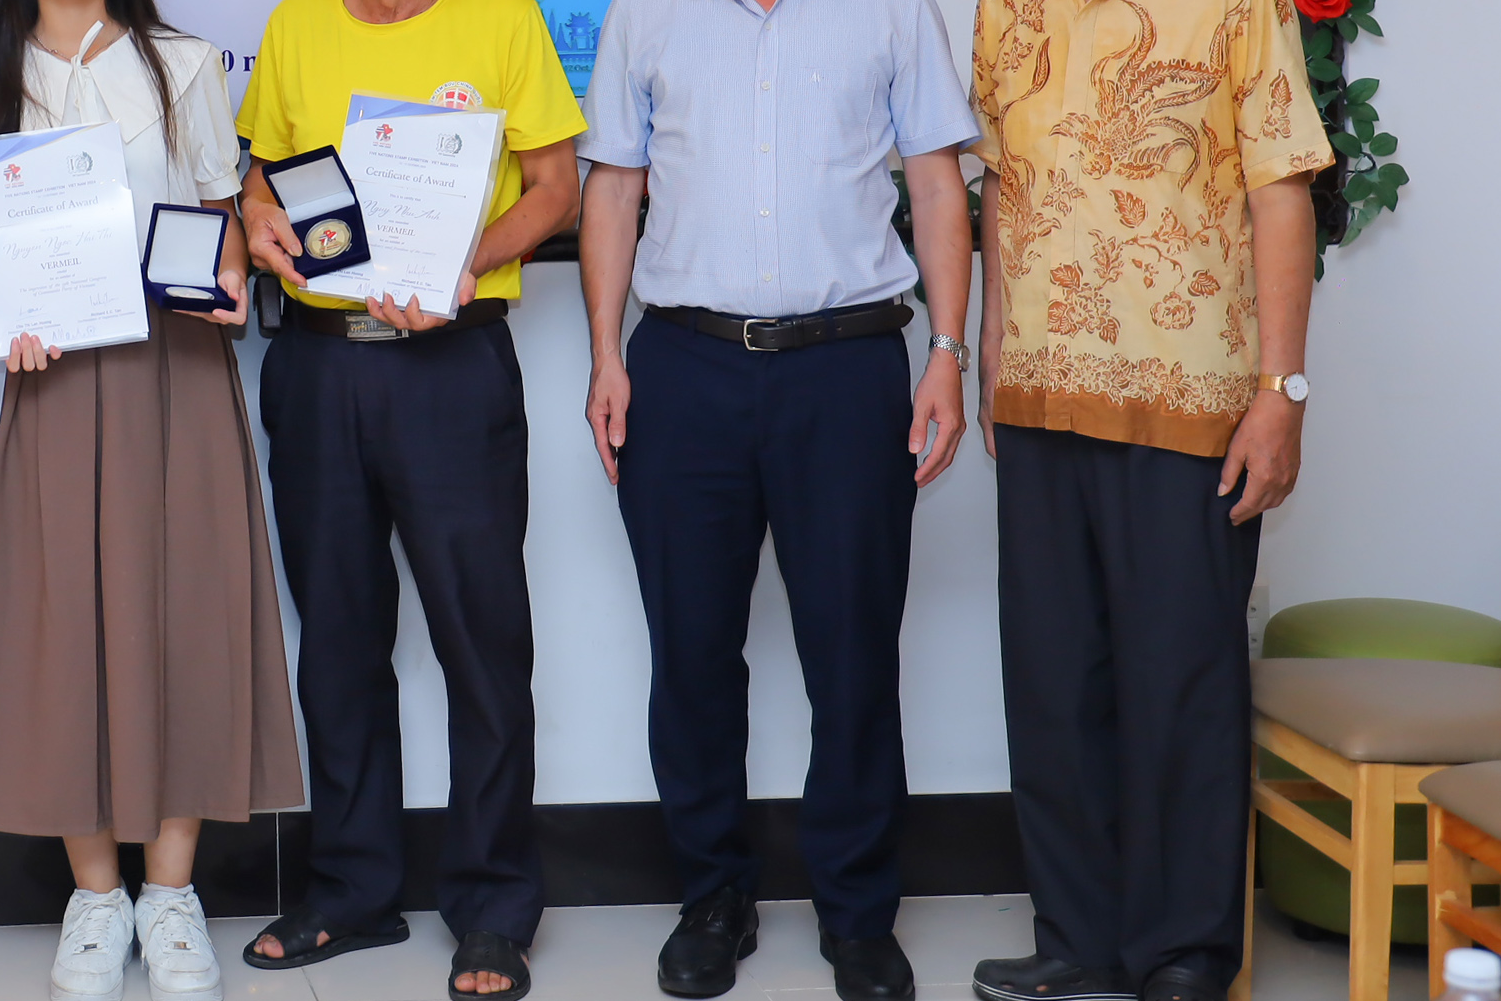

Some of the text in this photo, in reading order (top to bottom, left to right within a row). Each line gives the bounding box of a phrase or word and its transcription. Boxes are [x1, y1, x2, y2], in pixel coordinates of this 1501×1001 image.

[366, 166, 455, 188] Certificate of Award
[8, 196, 99, 218] Certificate of Award
[377, 224, 416, 236] VERMEIL
[40, 258, 82, 270] VERMEIL
